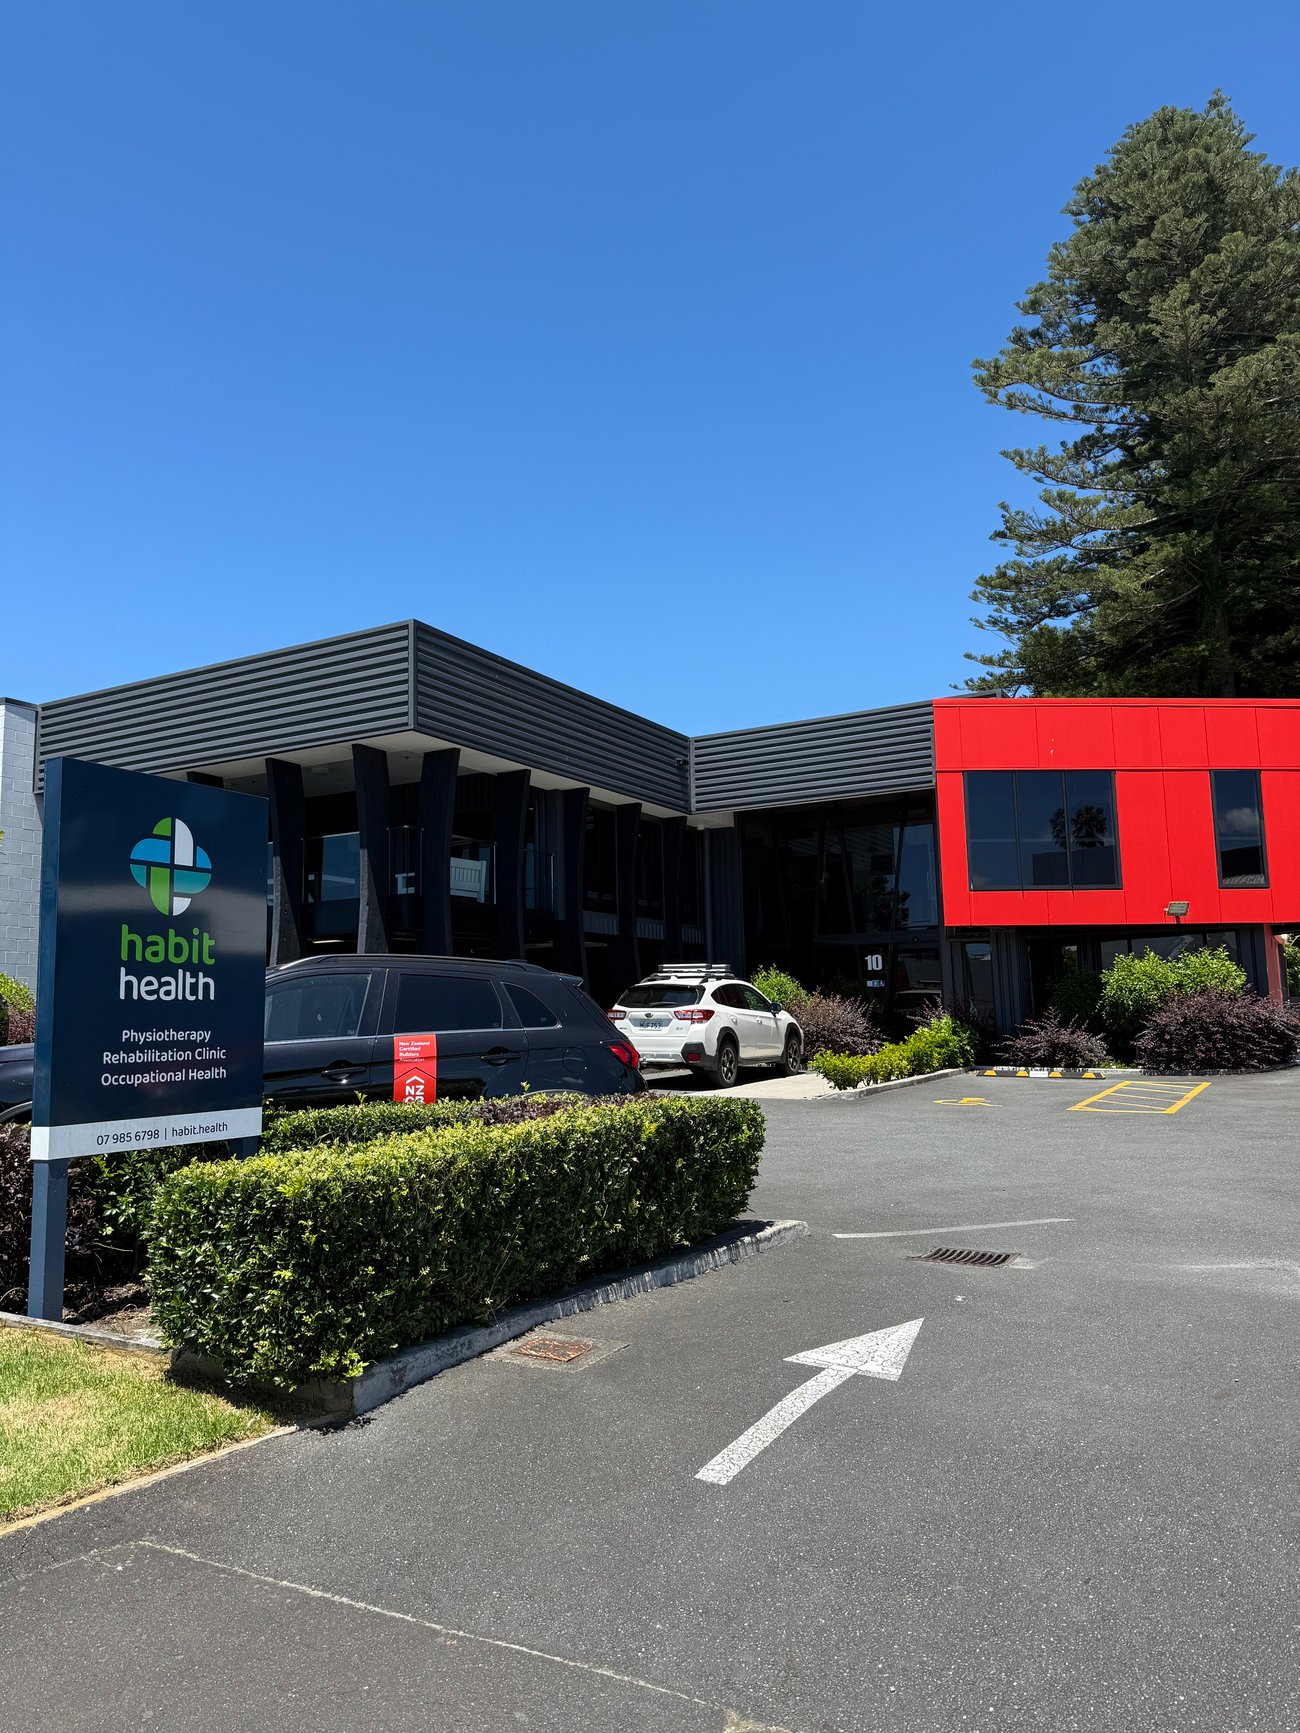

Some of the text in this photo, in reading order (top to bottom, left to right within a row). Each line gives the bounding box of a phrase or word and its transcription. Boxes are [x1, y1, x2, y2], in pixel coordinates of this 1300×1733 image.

[121, 924, 216, 965] habit
[864, 954, 883, 970] 10
[120, 967, 215, 1001] health
[122, 1028, 212, 1045] Physiotherapy
[103, 1046, 227, 1065] Rehabilitation Clinic
[101, 1066, 227, 1087] Occupational Health
[405, 1085, 425, 1096] NZ
[96, 1134, 110, 1146] 07
[112, 1132, 132, 1144] 985
[134, 1129, 160, 1142] 6798
[171, 1121, 228, 1138] habit.health
